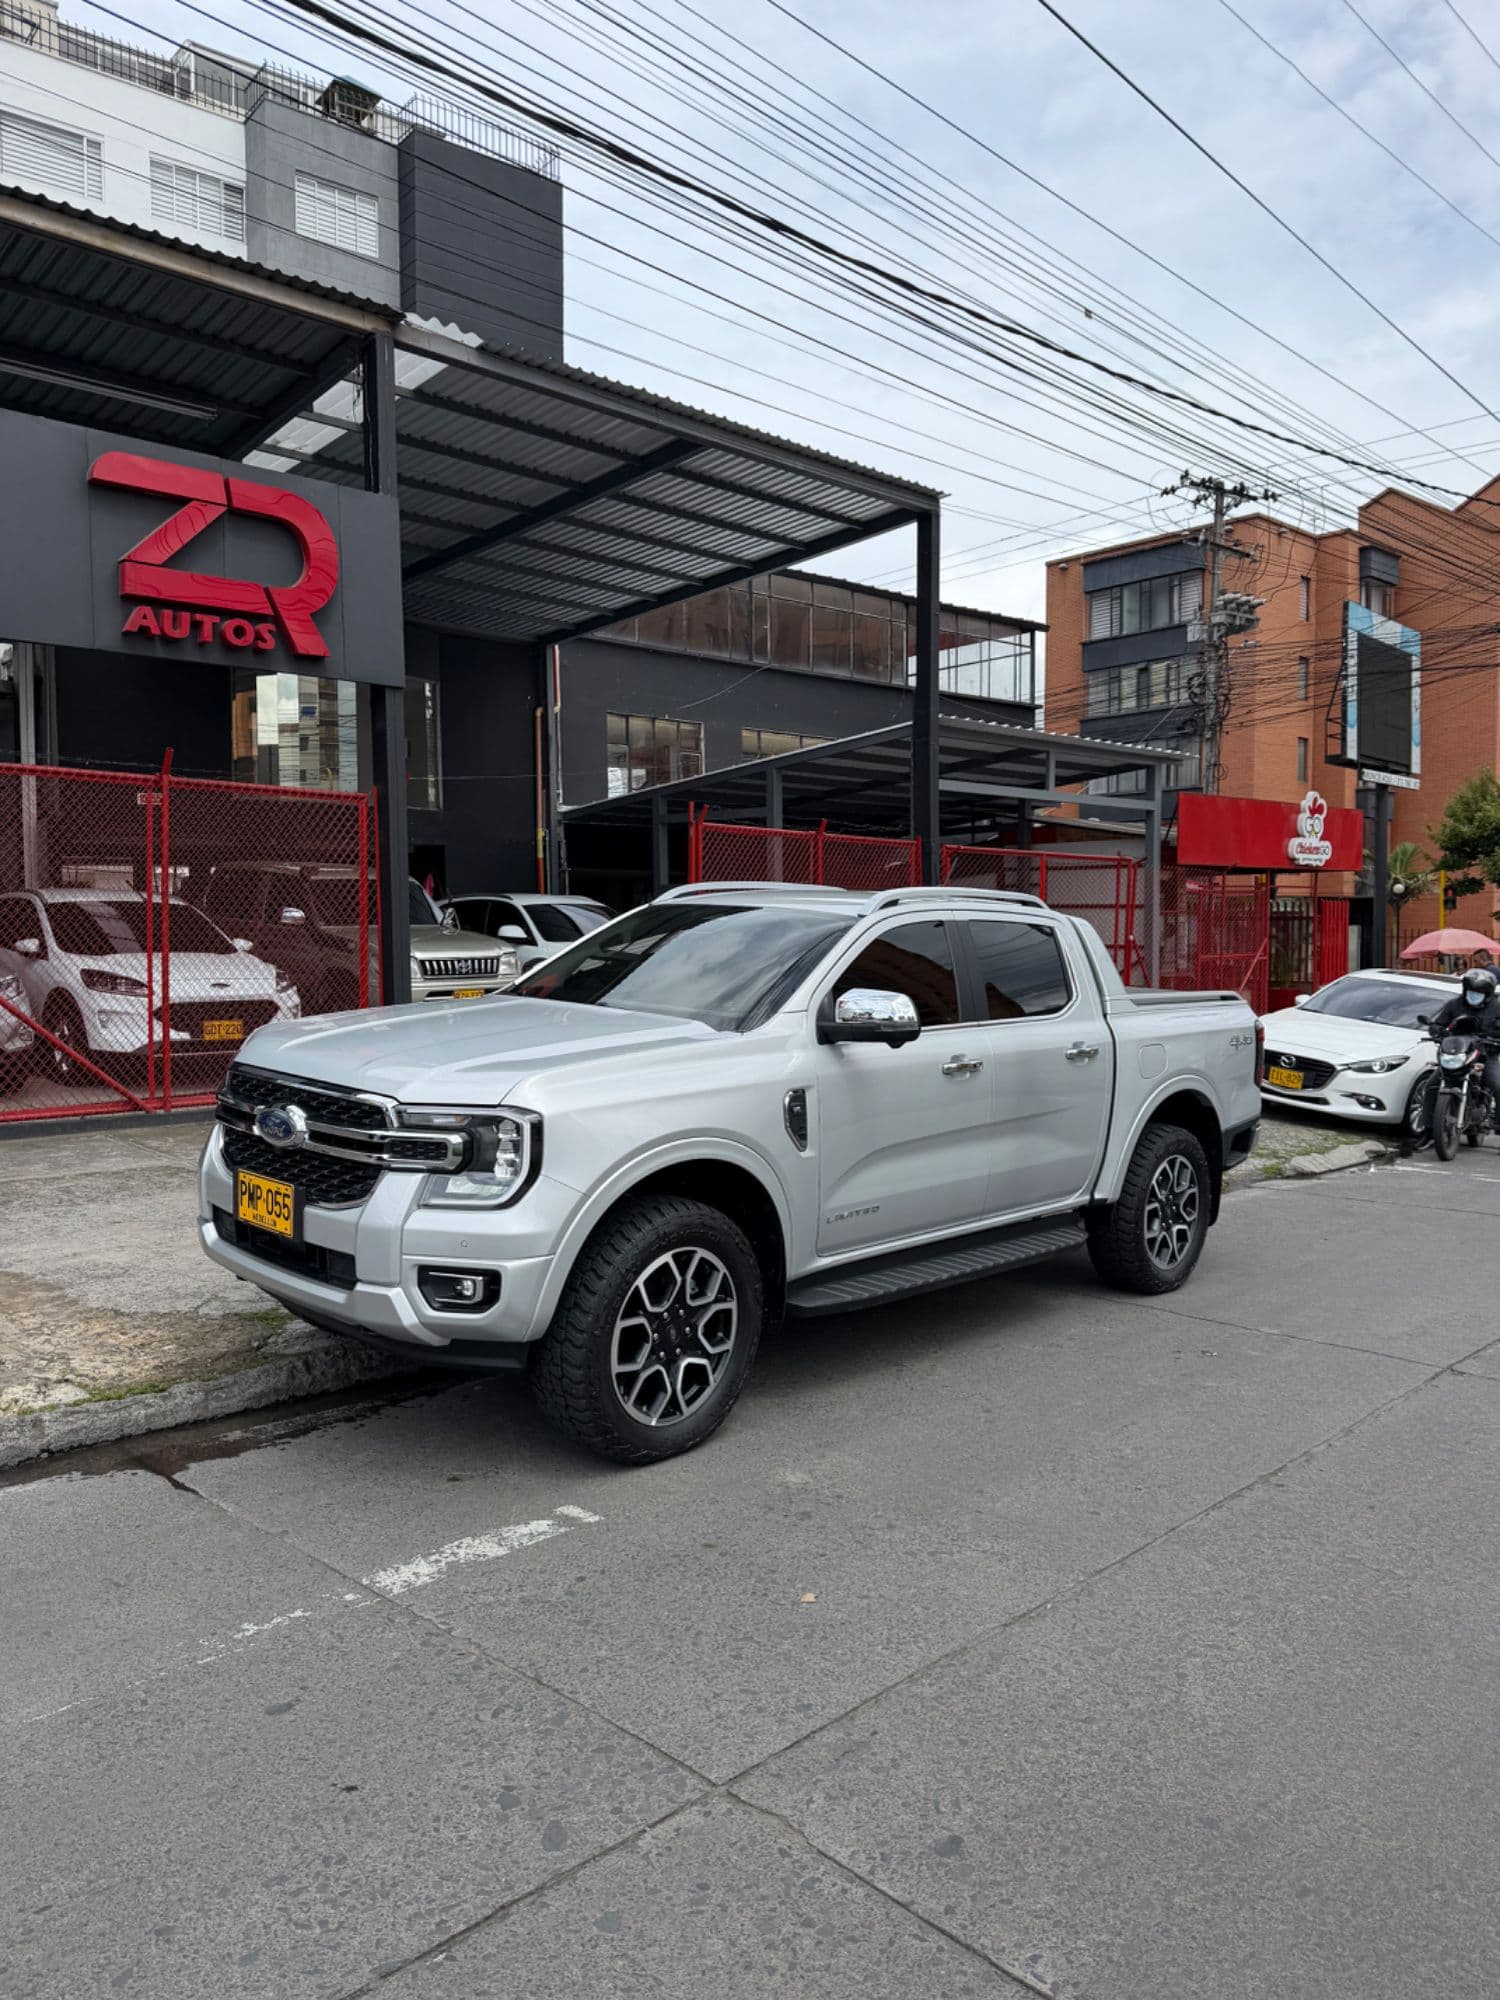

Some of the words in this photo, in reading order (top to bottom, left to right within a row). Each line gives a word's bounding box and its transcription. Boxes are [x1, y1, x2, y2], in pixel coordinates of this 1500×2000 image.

[87, 451, 338, 657] ZR
[120, 604, 277, 651] AUTOS
[1304, 815, 1321, 835] GO
